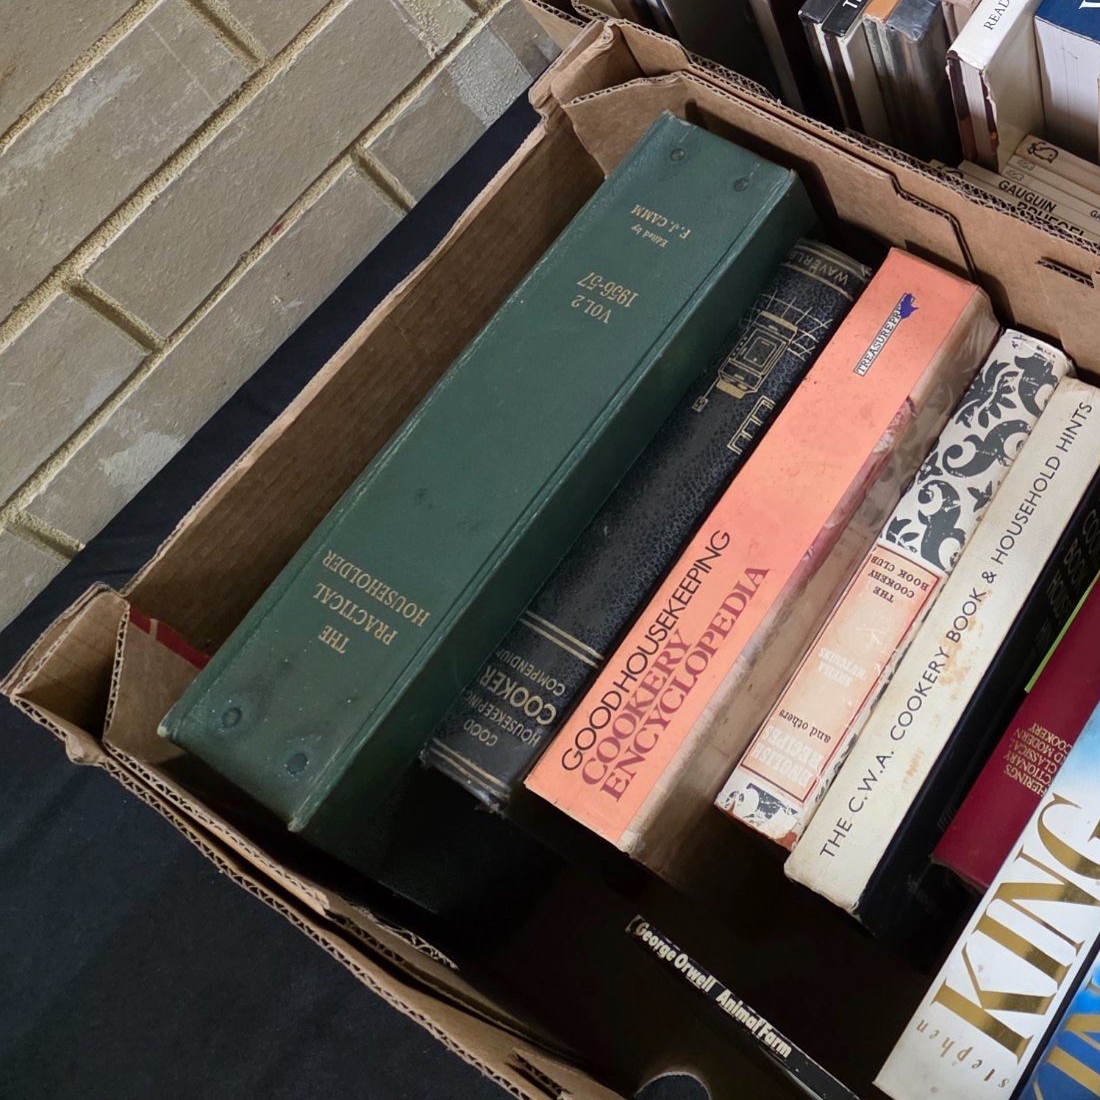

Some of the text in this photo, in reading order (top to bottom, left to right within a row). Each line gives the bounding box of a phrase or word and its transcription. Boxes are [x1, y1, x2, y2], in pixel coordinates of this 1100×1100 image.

[630, 204, 668, 228] CAMM
[576, 271, 640, 309] 1956-57
[313, 582, 398, 647] PRACTICAL
[321, 550, 431, 628] HOUSEHOLDER
[868, 569, 916, 599] COOKERY
[900, 569, 930, 592] BOOK
[561, 530, 731, 772] GOOD HOUSEKEEPING
[820, 817, 853, 859] THE
[848, 750, 895, 814] C.W.A.
[890, 645, 950, 742] COOKERY
[946, 587, 988, 643] BOOK
[981, 569, 998, 585] &
[990, 454, 1062, 566] HOUSEHOLD
[1058, 400, 1095, 455] HINTS
[581, 630, 692, 786] COOKERY
[600, 565, 770, 802] ENCYCLOPEDIA
[779, 709, 832, 744] and others
[635, 922, 793, 1058] George Orwell Animal Farm
[915, 1018, 1011, 1089] stephen
